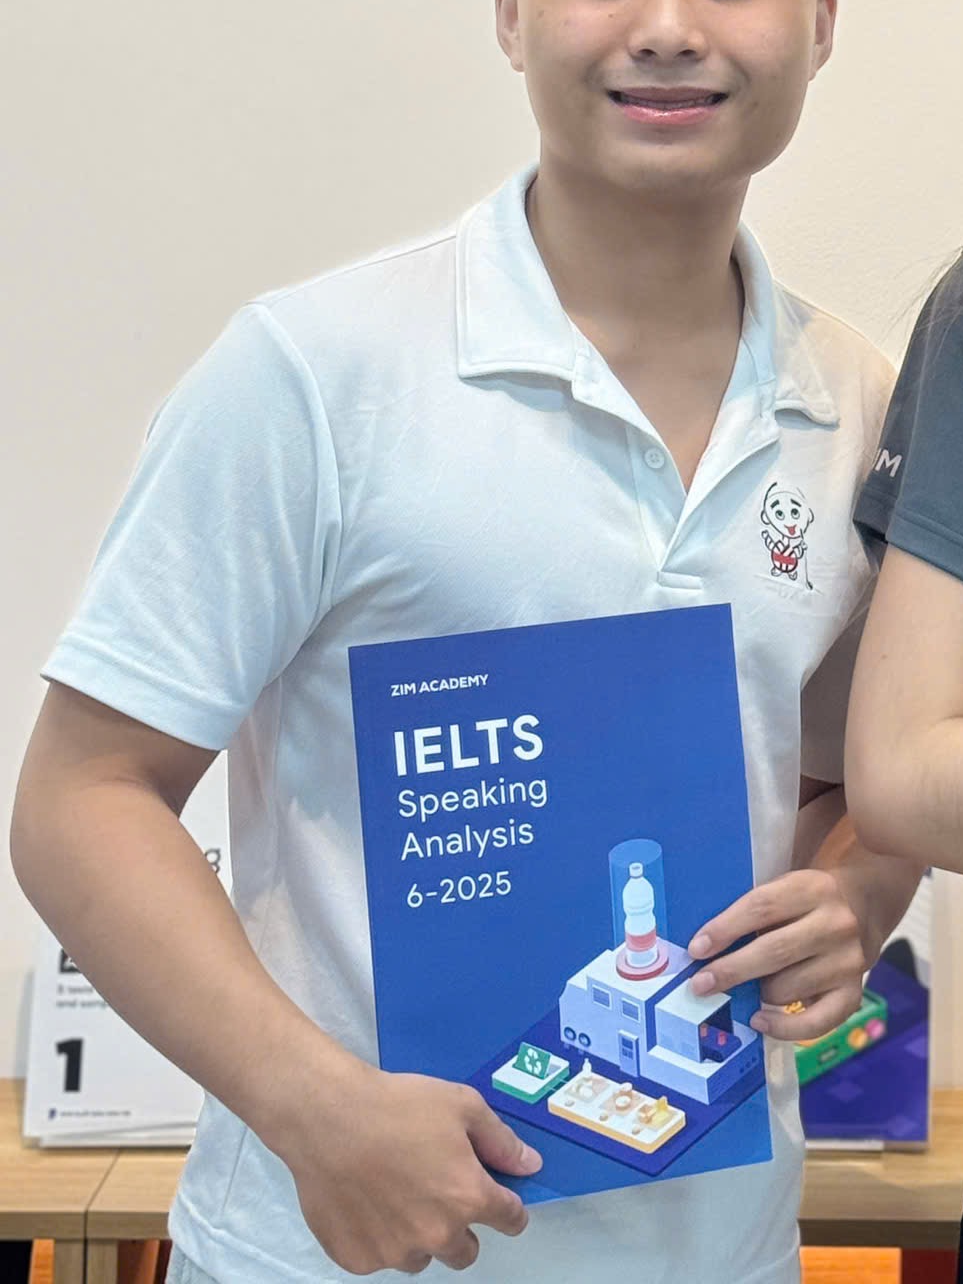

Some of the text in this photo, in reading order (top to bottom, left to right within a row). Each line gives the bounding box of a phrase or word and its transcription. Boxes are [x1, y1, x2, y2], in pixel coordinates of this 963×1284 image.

[391, 673, 489, 697] ZIM ACADEMY
[393, 714, 544, 777] IELTS
[398, 777, 548, 822] Speaking
[400, 819, 535, 861] Analysis
[406, 871, 512, 909] 6-2025
[55, 1037, 84, 1094] 1
